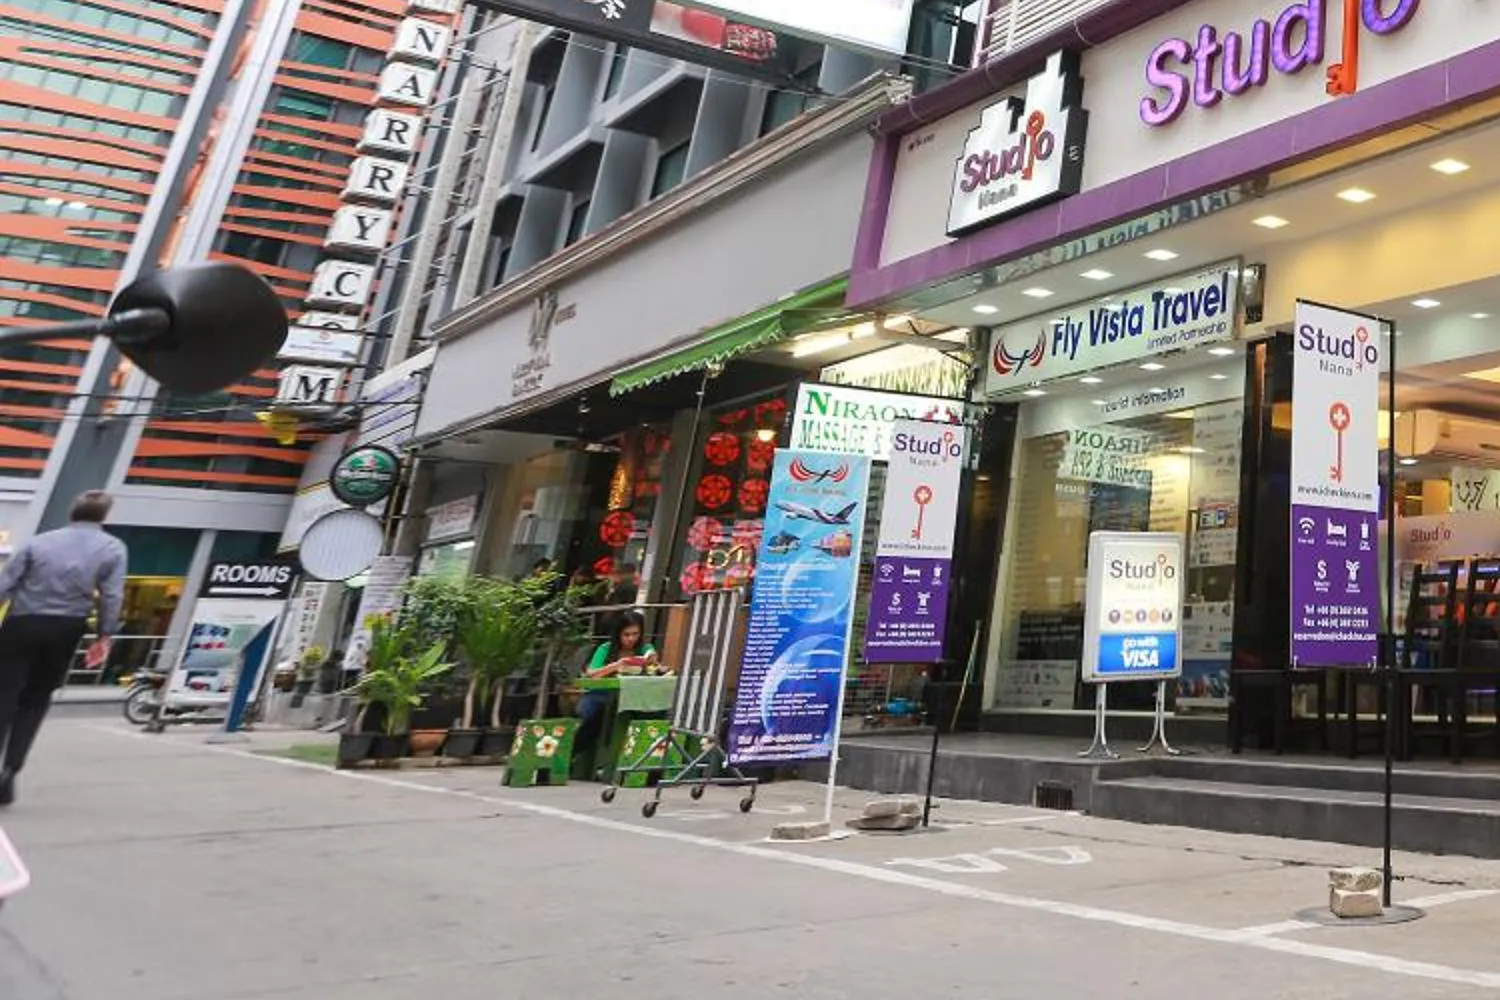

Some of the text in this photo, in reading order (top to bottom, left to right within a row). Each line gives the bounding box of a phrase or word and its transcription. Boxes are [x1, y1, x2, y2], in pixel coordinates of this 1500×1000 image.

[959, 110, 1054, 193] Studio
[1052, 271, 1229, 360] Fly Vista Travel
[1298, 325, 1379, 372] Studio
[1319, 359, 1354, 377] Nana
[895, 431, 961, 463] Studio
[210, 564, 292, 584] ROOMS
[1109, 553, 1176, 587] Studio
[1121, 650, 1159, 668] VISA
